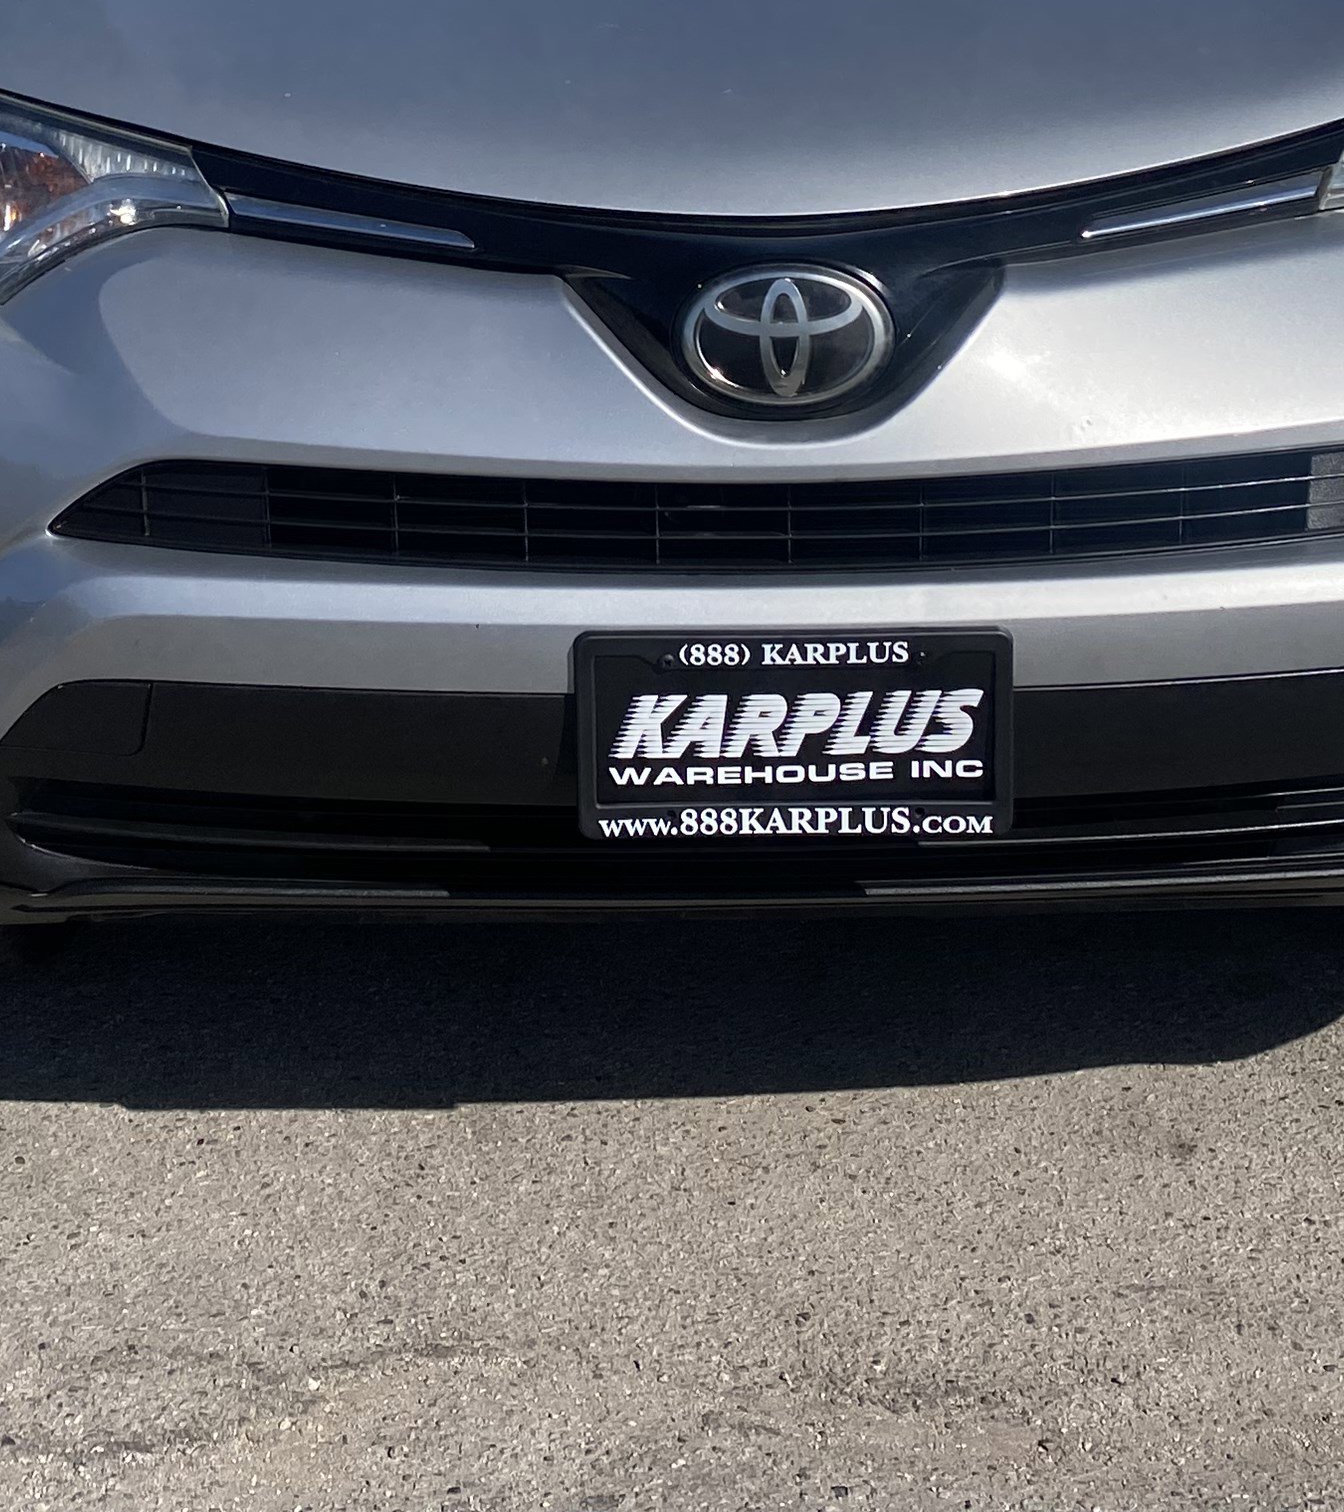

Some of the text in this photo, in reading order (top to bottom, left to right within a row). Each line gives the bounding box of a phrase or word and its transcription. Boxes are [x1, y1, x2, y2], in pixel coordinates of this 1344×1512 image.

[679, 641, 909, 666] (888) KARPLUS
[608, 688, 985, 759] KARPLUS
[609, 759, 985, 787] WAREHOUSE INC
